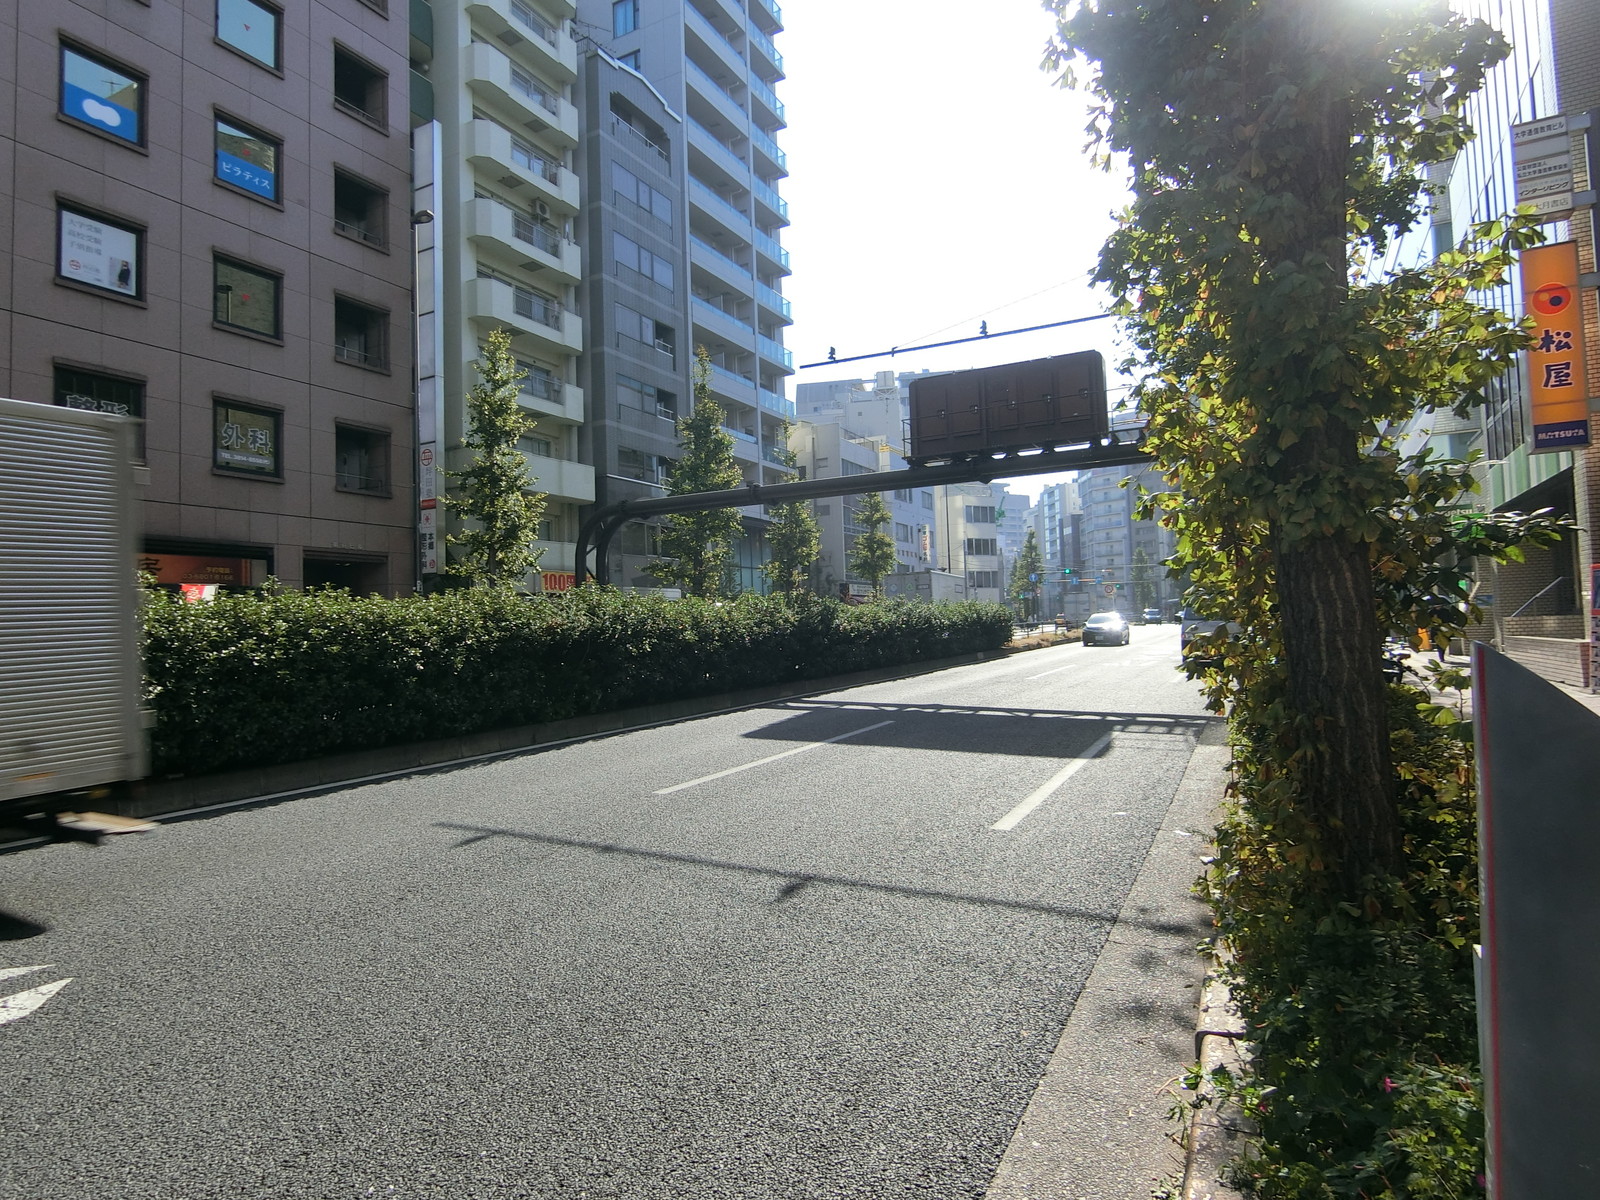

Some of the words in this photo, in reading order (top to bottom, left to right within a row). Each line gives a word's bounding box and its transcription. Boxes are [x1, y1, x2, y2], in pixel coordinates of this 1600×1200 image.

[222, 161, 270, 189] ピラティス
[1539, 329, 1573, 389] 松屋
[222, 422, 271, 454] 外科
[1537, 428, 1586, 440] MATSUYA
